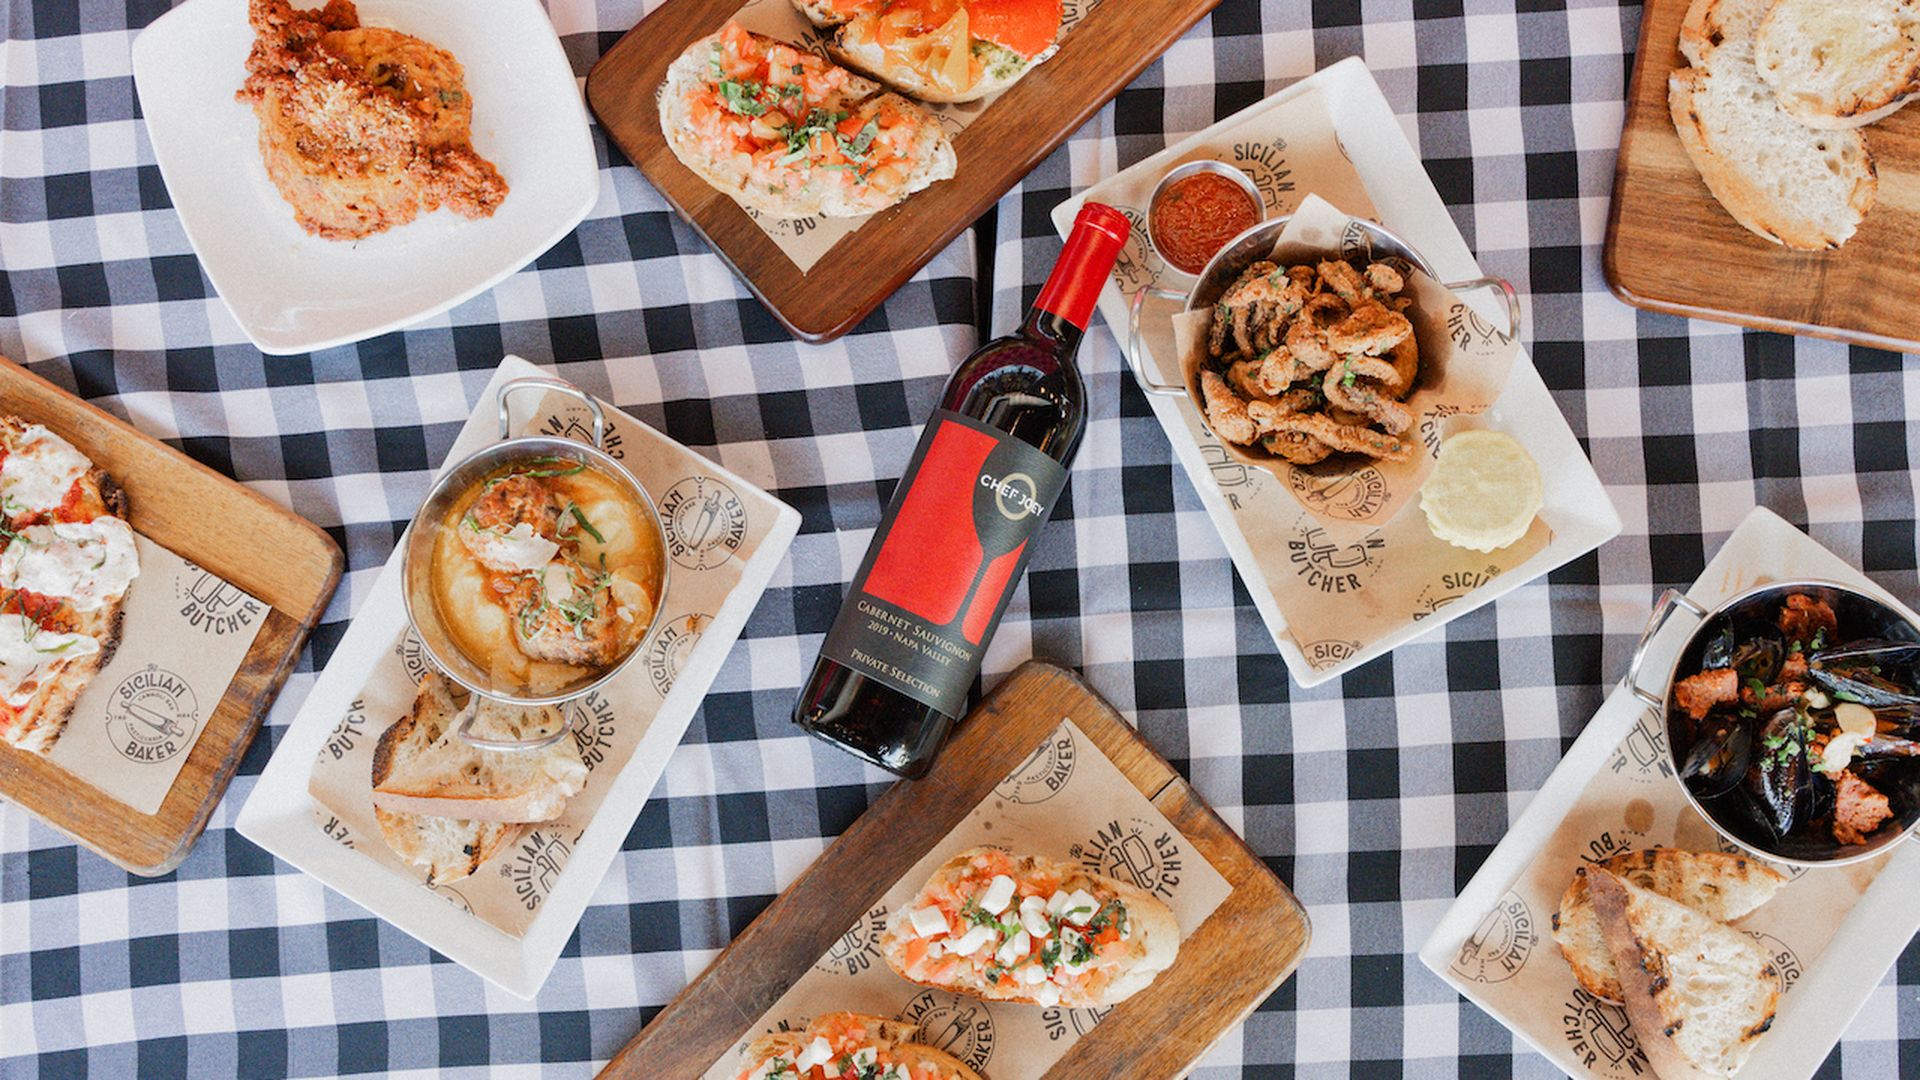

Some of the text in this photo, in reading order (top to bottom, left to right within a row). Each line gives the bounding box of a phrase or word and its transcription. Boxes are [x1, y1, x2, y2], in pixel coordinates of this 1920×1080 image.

[1233, 142, 1295, 192] SICILIAN
[980, 473, 1045, 517] CHEF JOEY
[1347, 469, 1383, 518] SICILIAN
[724, 497, 744, 550] BAKER
[1288, 541, 1362, 593] BUTCHER
[180, 600, 262, 636] BUTCHER
[857, 599, 973, 662] CABERNET SAUVIGNON
[866, 620, 952, 667] 2019 NAPA VALLEY
[119, 673, 187, 700] SICILIAN
[651, 626, 678, 695] SICILIAN
[851, 648, 942, 698] PRIVATE SELECTION
[125, 741, 177, 761] BAKER
[581, 690, 615, 772] BUTCHER
[1045, 738, 1072, 792] BAKER
[513, 831, 546, 911] SICILIAN
[1500, 902, 1530, 973] SICILIAN
[965, 1019, 993, 1073] BAKER
